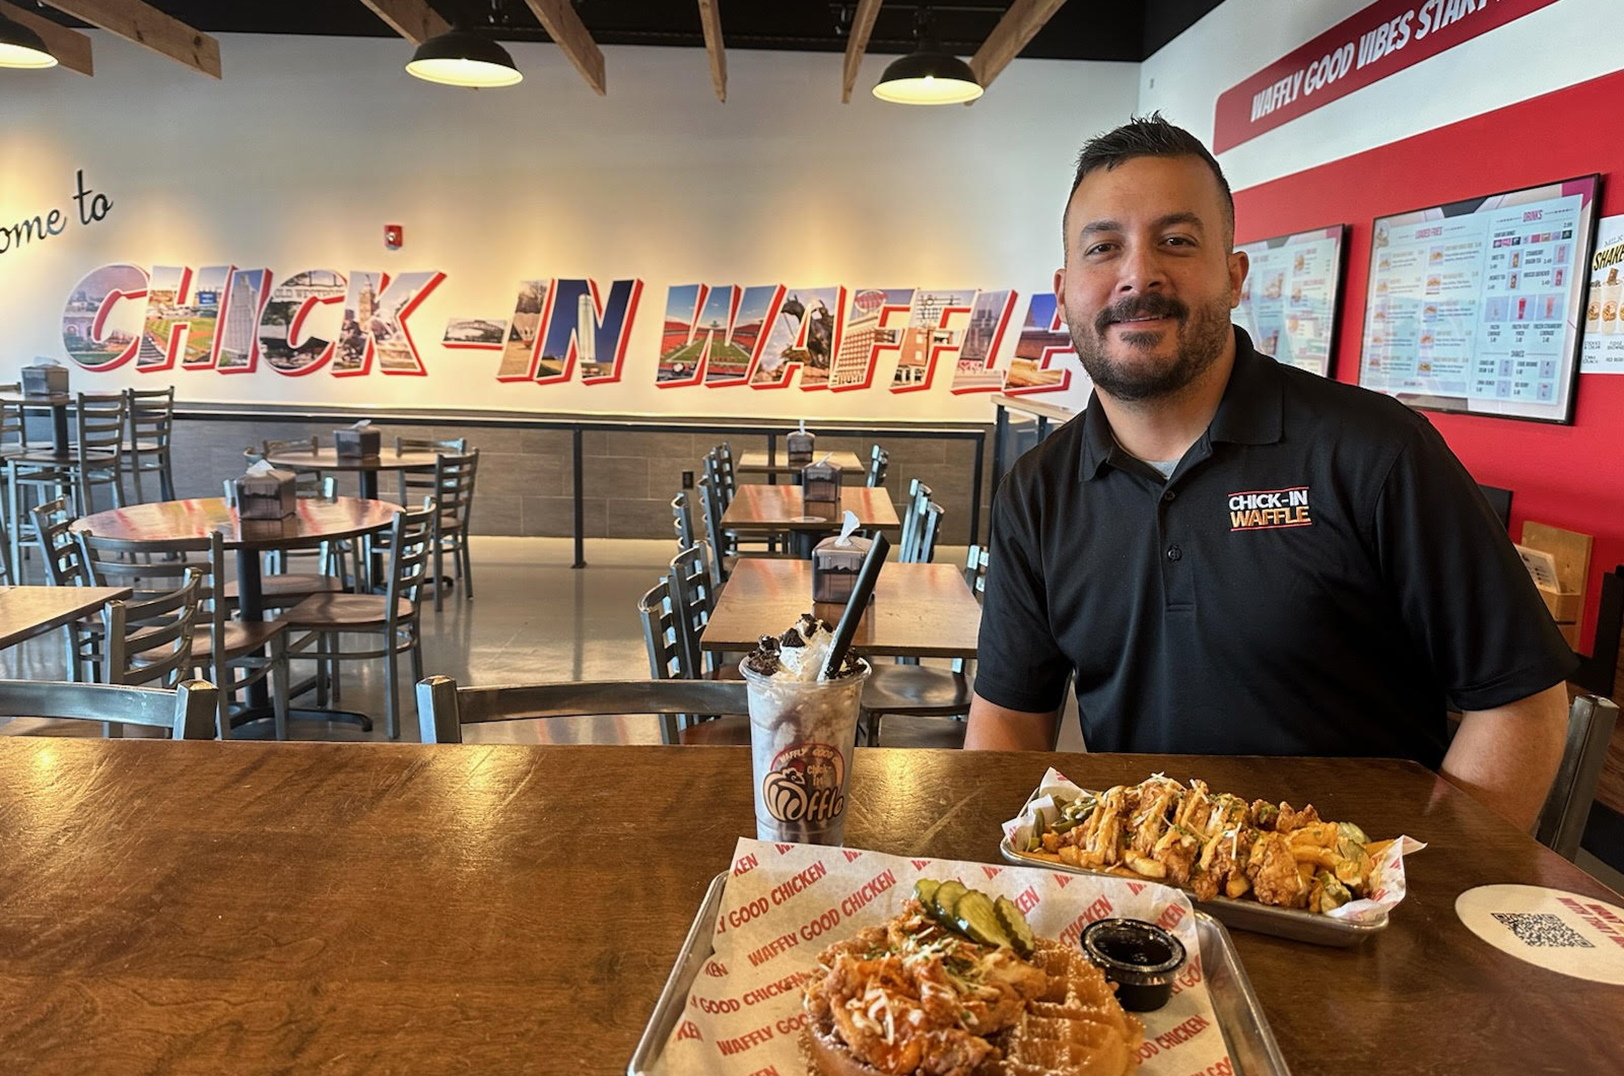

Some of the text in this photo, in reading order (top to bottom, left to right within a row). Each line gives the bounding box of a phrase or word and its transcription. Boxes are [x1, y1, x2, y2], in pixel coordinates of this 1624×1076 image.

[1250, 69, 1304, 122] WAFFLY
[1303, 42, 1355, 96] GOOD
[1356, 9, 1413, 70] VIBES
[72, 169, 114, 225] to
[654, 282, 1076, 396] WAFFLE
[1228, 490, 1308, 511] CHICK-IN
[1230, 506, 1311, 528] WAFFLE
[779, 747, 808, 763] WAFFLY
[728, 896, 769, 929] GOOD
[770, 860, 827, 906] CHICKEN
[747, 868, 897, 968] WAFFLY GOOD CHICKEN
[700, 995, 741, 1015] GOOD
[742, 972, 806, 1006] CHICKEN
[716, 1025, 774, 1056] WAFFLY
[1155, 1014, 1210, 1050] CHICKEN
